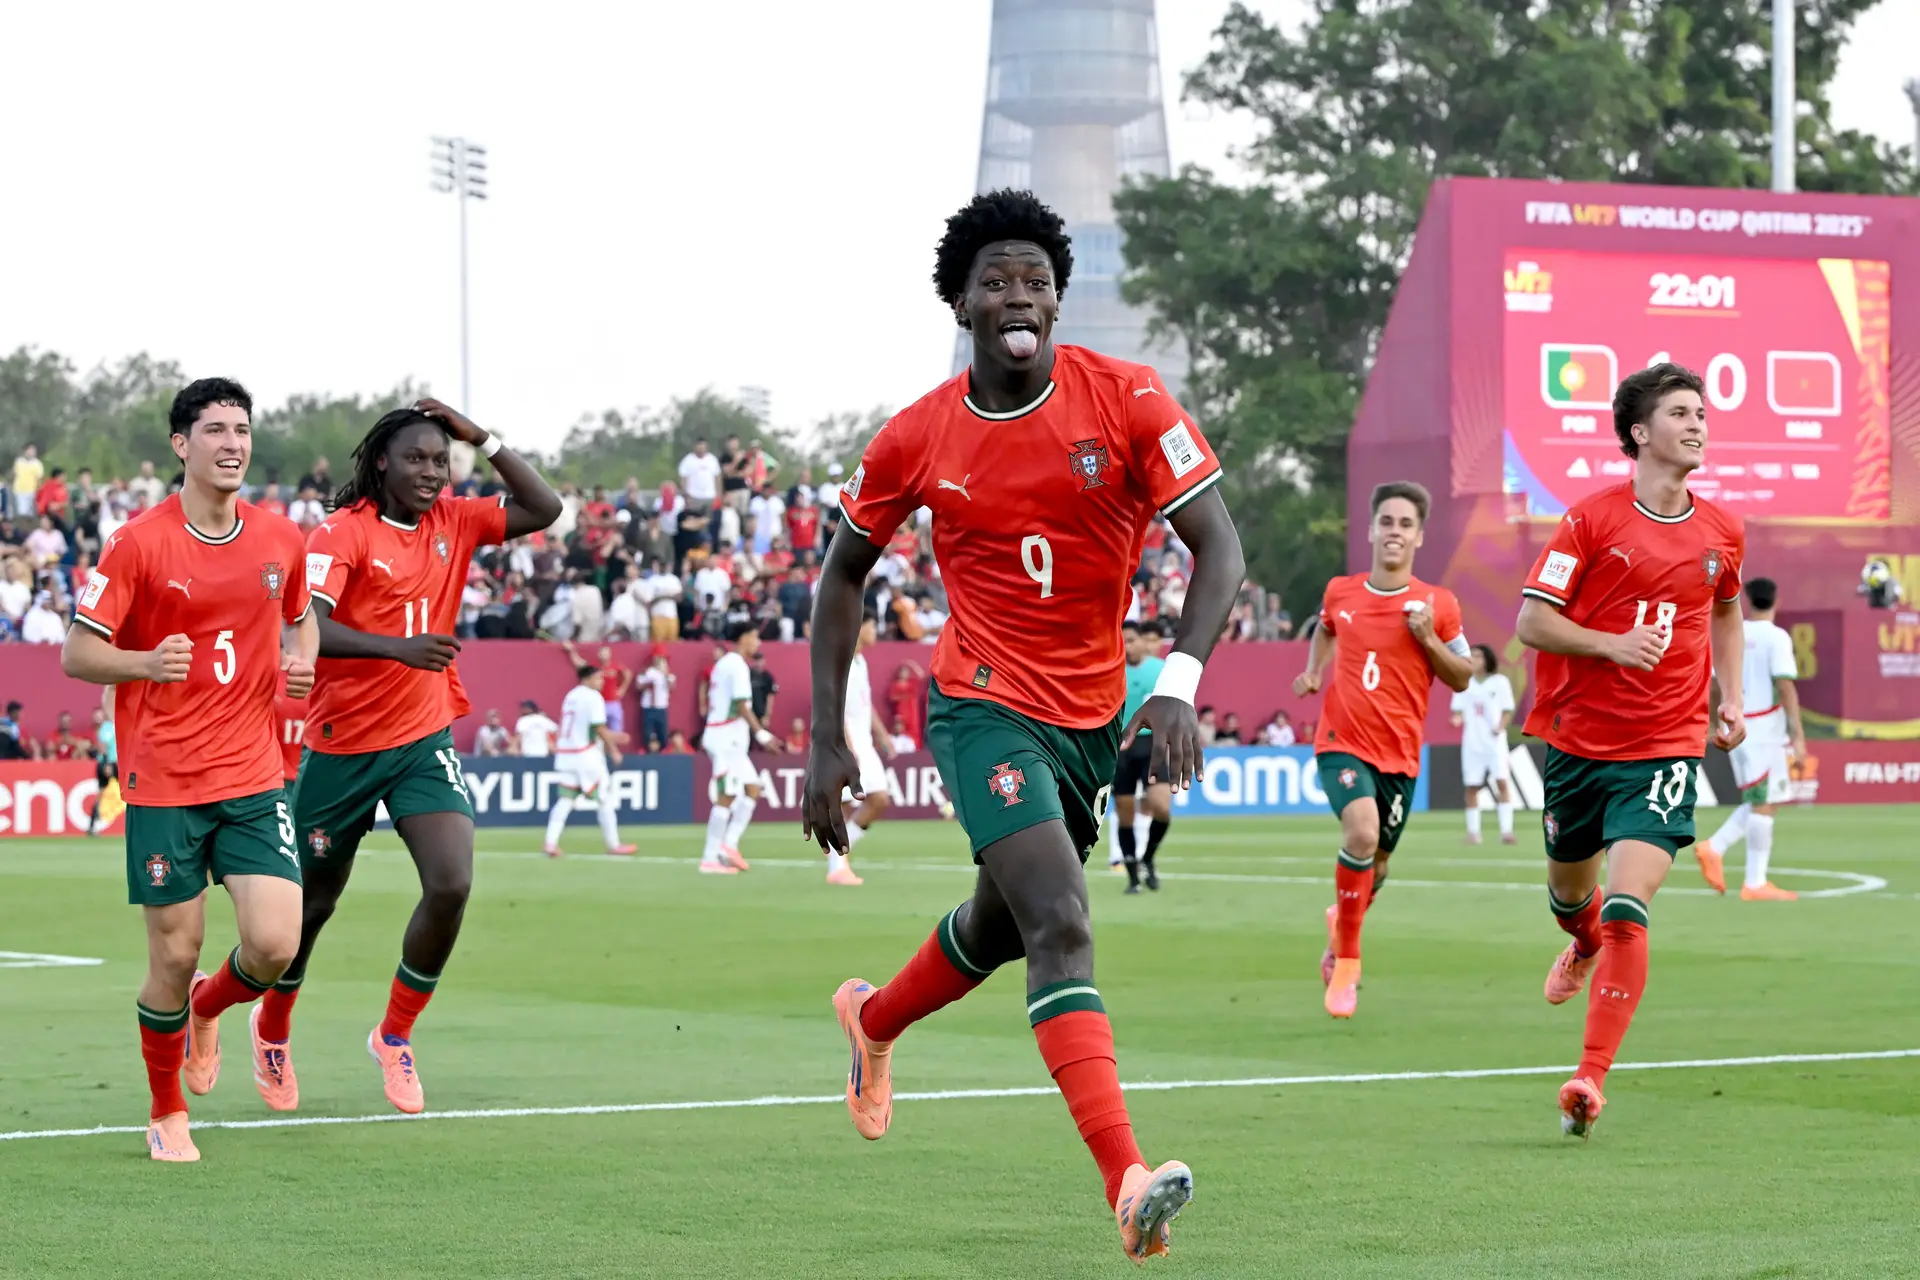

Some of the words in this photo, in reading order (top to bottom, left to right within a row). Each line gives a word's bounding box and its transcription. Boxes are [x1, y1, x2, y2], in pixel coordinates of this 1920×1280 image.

[1525, 202, 1572, 225] FIFA
[1619, 205, 1695, 231] WORLD
[1697, 208, 1740, 232] CUP
[1649, 272, 1735, 308] 22:01
[1705, 353, 1747, 411] 0
[1021, 534, 1054, 599] 9
[404, 597, 429, 638] 11
[213, 630, 236, 685] 5
[1362, 650, 1380, 692] 6
[284, 718, 305, 745] 17
[435, 748, 466, 788] 11
[1645, 761, 1688, 807] 18
[1845, 762, 1884, 784] FIFA
[276, 802, 294, 844] 5
[1388, 793, 1404, 828] 6
